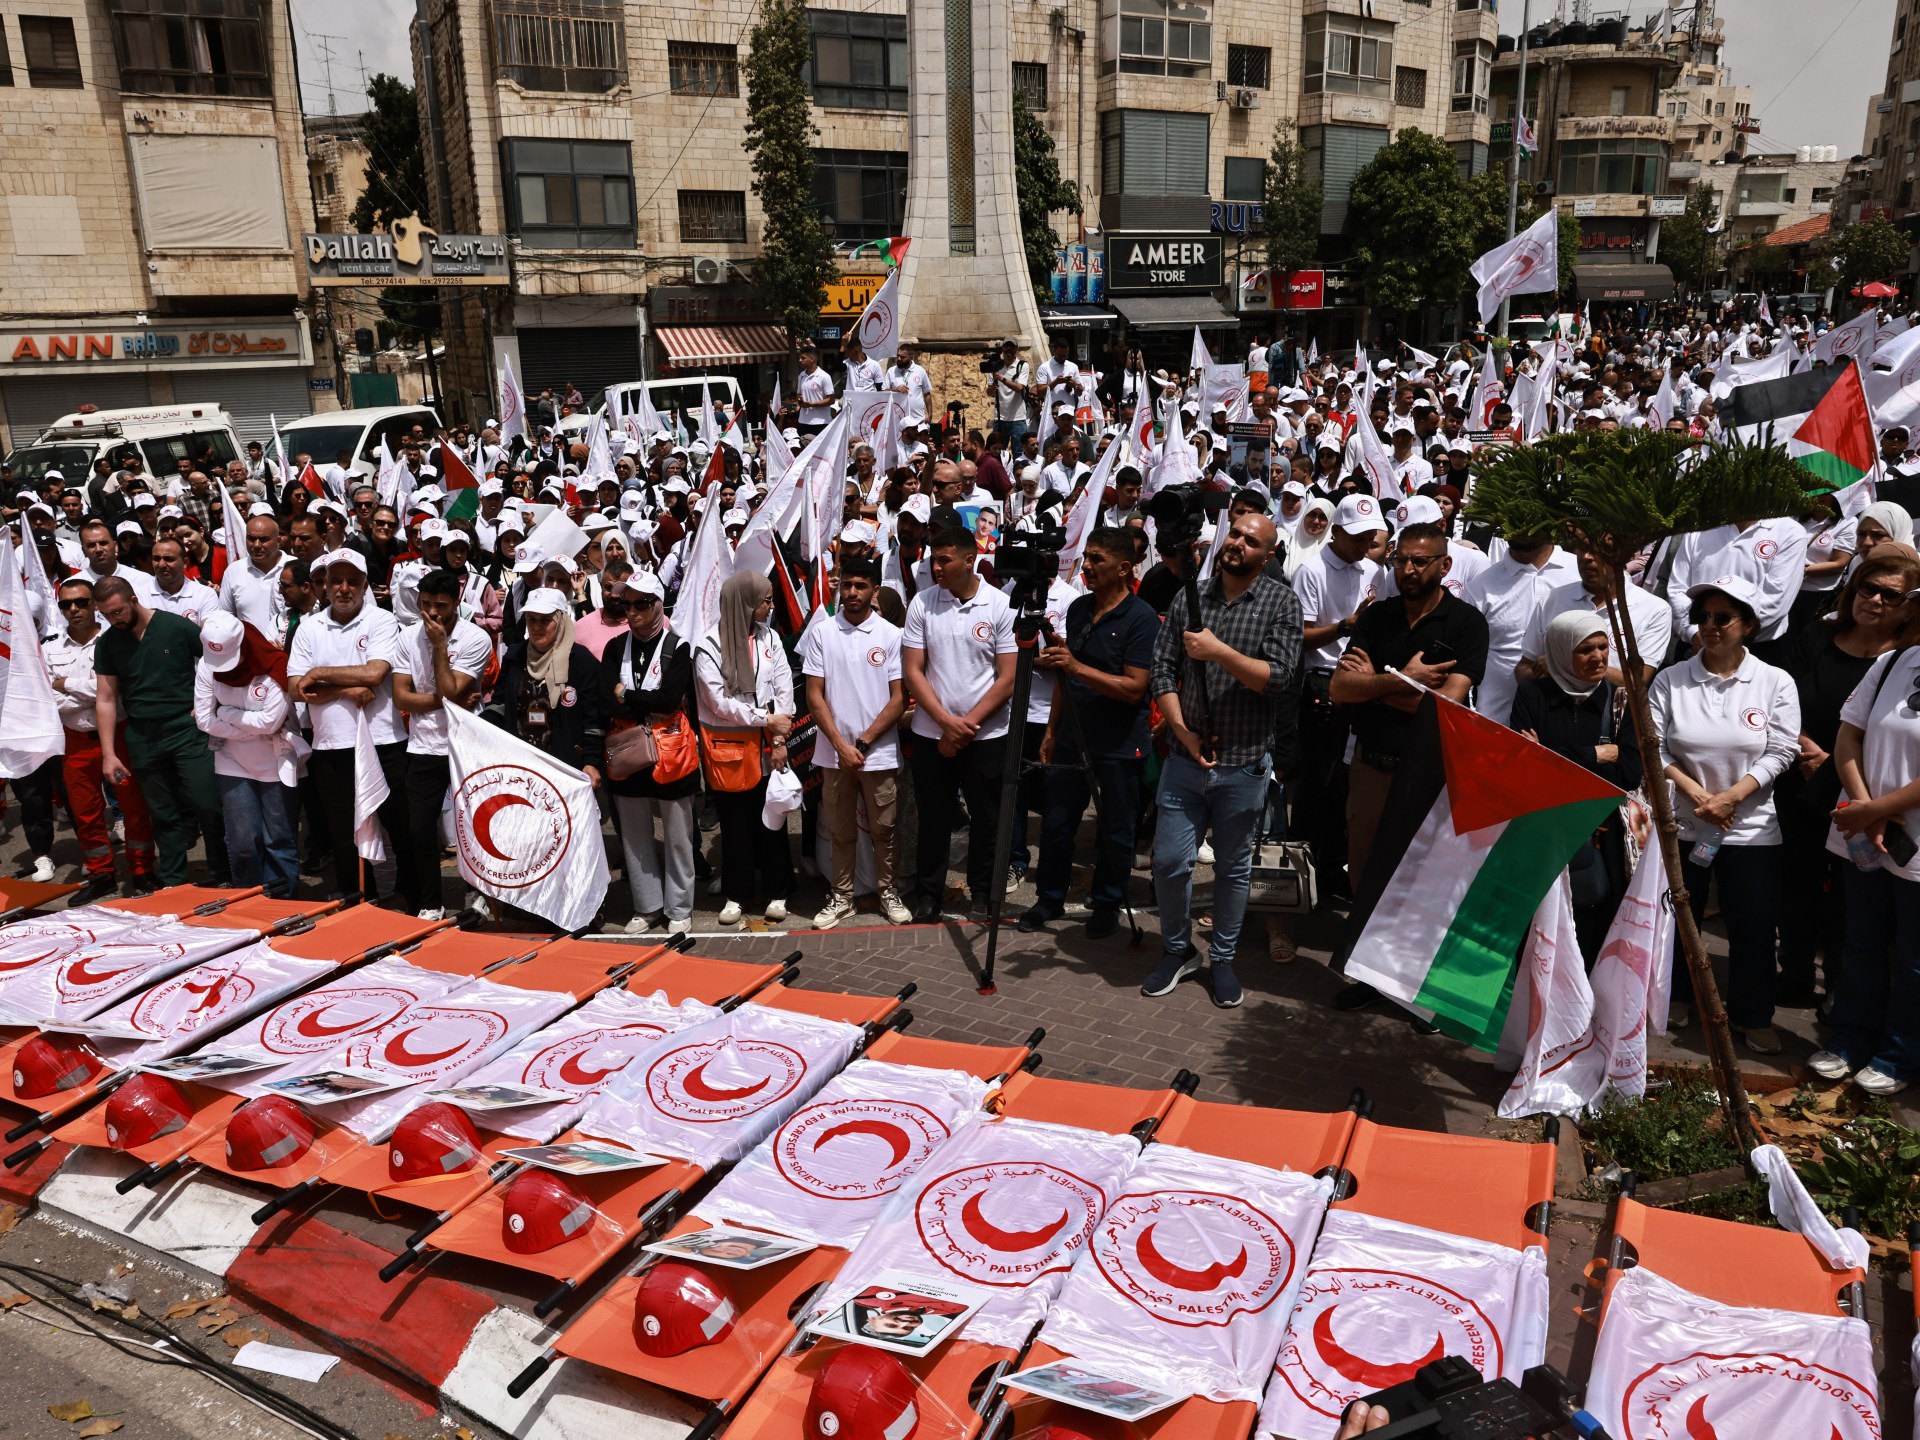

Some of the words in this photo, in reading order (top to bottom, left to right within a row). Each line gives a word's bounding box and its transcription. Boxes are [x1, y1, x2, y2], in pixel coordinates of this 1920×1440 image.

[307, 235, 393, 261] Dallah
[428, 239, 474, 262] البركة
[1127, 243, 1206, 266] AMEER
[341, 262, 364, 273] rent
[365, 265, 372, 273] a
[374, 265, 391, 273] car
[1070, 252, 1086, 272] XL
[1089, 257, 1103, 274] XL
[847, 278, 876, 287] BAKERYS
[1150, 270, 1186, 283] STORE
[12, 335, 114, 359] ANN
[188, 332, 210, 353] آن
[212, 332, 287, 353] محلات
[101, 414, 131, 424] الصحية
[133, 412, 162, 421] الرعاية
[787, 737, 801, 749] DIES
[800, 725, 818, 740] WHEN
[458, 809, 471, 853] PALESTINE
[471, 856, 485, 872] RED
[487, 869, 529, 880] CRESCENT
[530, 847, 558, 874] SOCIETY
[1252, 883, 1289, 891] BURBERRY
[444, 1059, 466, 1072] RED
[688, 1105, 748, 1115] PALESTINE
[804, 1112, 826, 1127] RED
[831, 1105, 892, 1116] PALESTINE
[786, 1125, 807, 1160] CRESCENT
[789, 1161, 824, 1187] SOCIETY
[955, 1168, 998, 1191] الهلال
[1003, 1168, 1047, 1179] جمعية
[1048, 1174, 1087, 1198] SOCIETY
[1082, 1195, 1097, 1240] CRESCENT
[1121, 1198, 1164, 1224] الهلال
[1216, 1202, 1265, 1232] SOCIETY
[1063, 1233, 1083, 1252] RED
[989, 1250, 1061, 1274] PALESTINE
[1260, 1233, 1282, 1280] CRESCENT
[1251, 1279, 1274, 1298] RED
[1301, 1276, 1346, 1303] الهلال
[1349, 1278, 1404, 1292] جمعية
[1178, 1291, 1250, 1315] PALESTINE
[1405, 1286, 1464, 1316] SOCIETY
[1458, 1317, 1486, 1374] CRESCENT
[1782, 1369, 1854, 1402] SOCIETY
